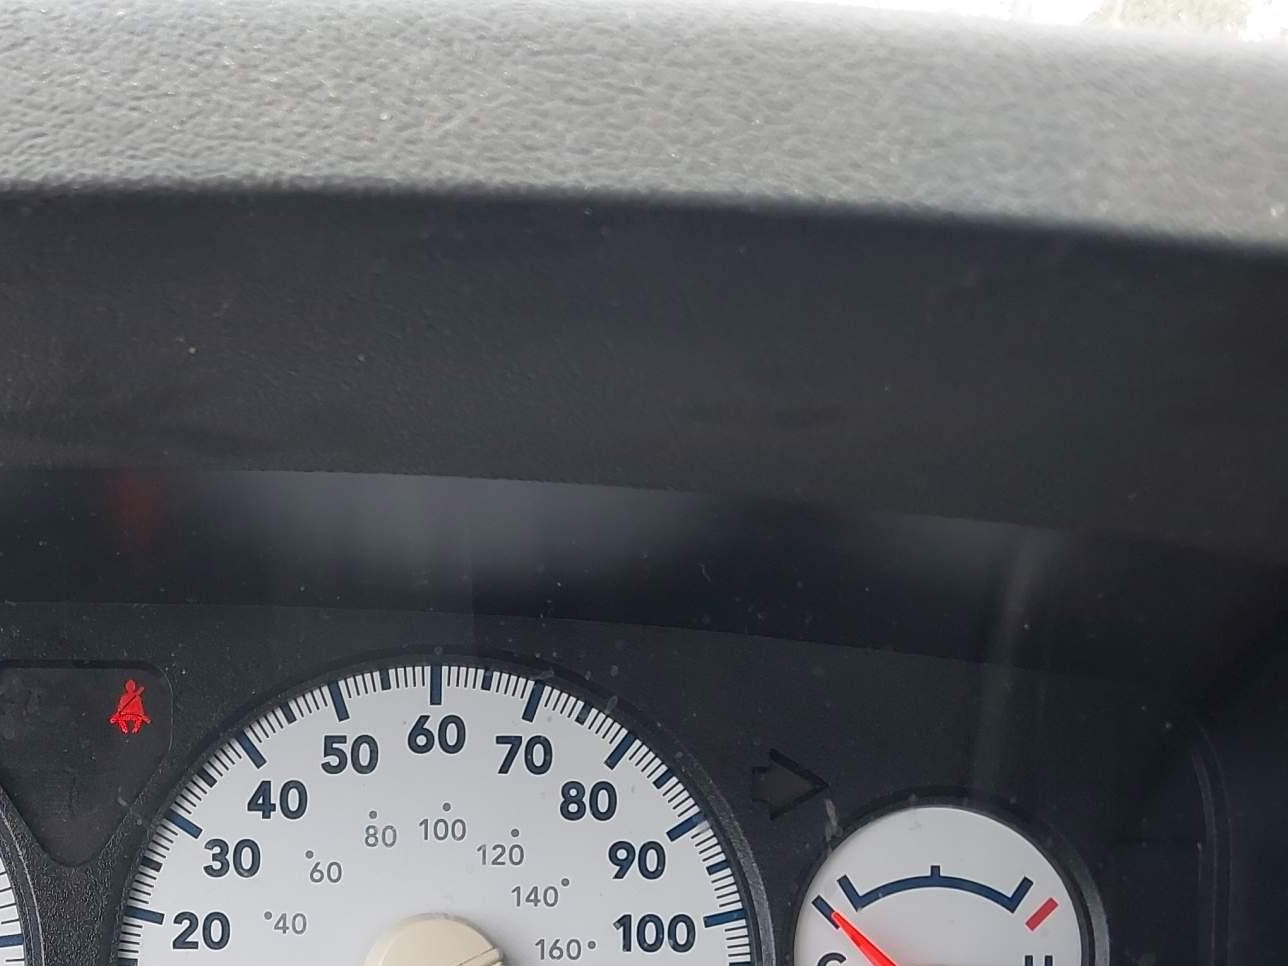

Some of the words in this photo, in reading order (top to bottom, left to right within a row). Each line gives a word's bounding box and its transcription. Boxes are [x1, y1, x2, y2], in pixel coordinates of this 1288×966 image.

[408, 715, 465, 754] 60
[321, 735, 378, 774] 50
[496, 735, 552, 775] 70
[248, 780, 307, 819] 40
[560, 781, 617, 821] 80
[365, 825, 396, 847] 80
[419, 819, 466, 840] 100
[204, 839, 260, 878] 30
[310, 862, 341, 883] 60
[477, 844, 524, 865] 120
[609, 841, 665, 879] 90
[512, 886, 558, 907] 140
[173, 912, 230, 950] 20
[273, 913, 307, 934] 40
[616, 914, 695, 952] 100
[535, 939, 581, 960] 160
